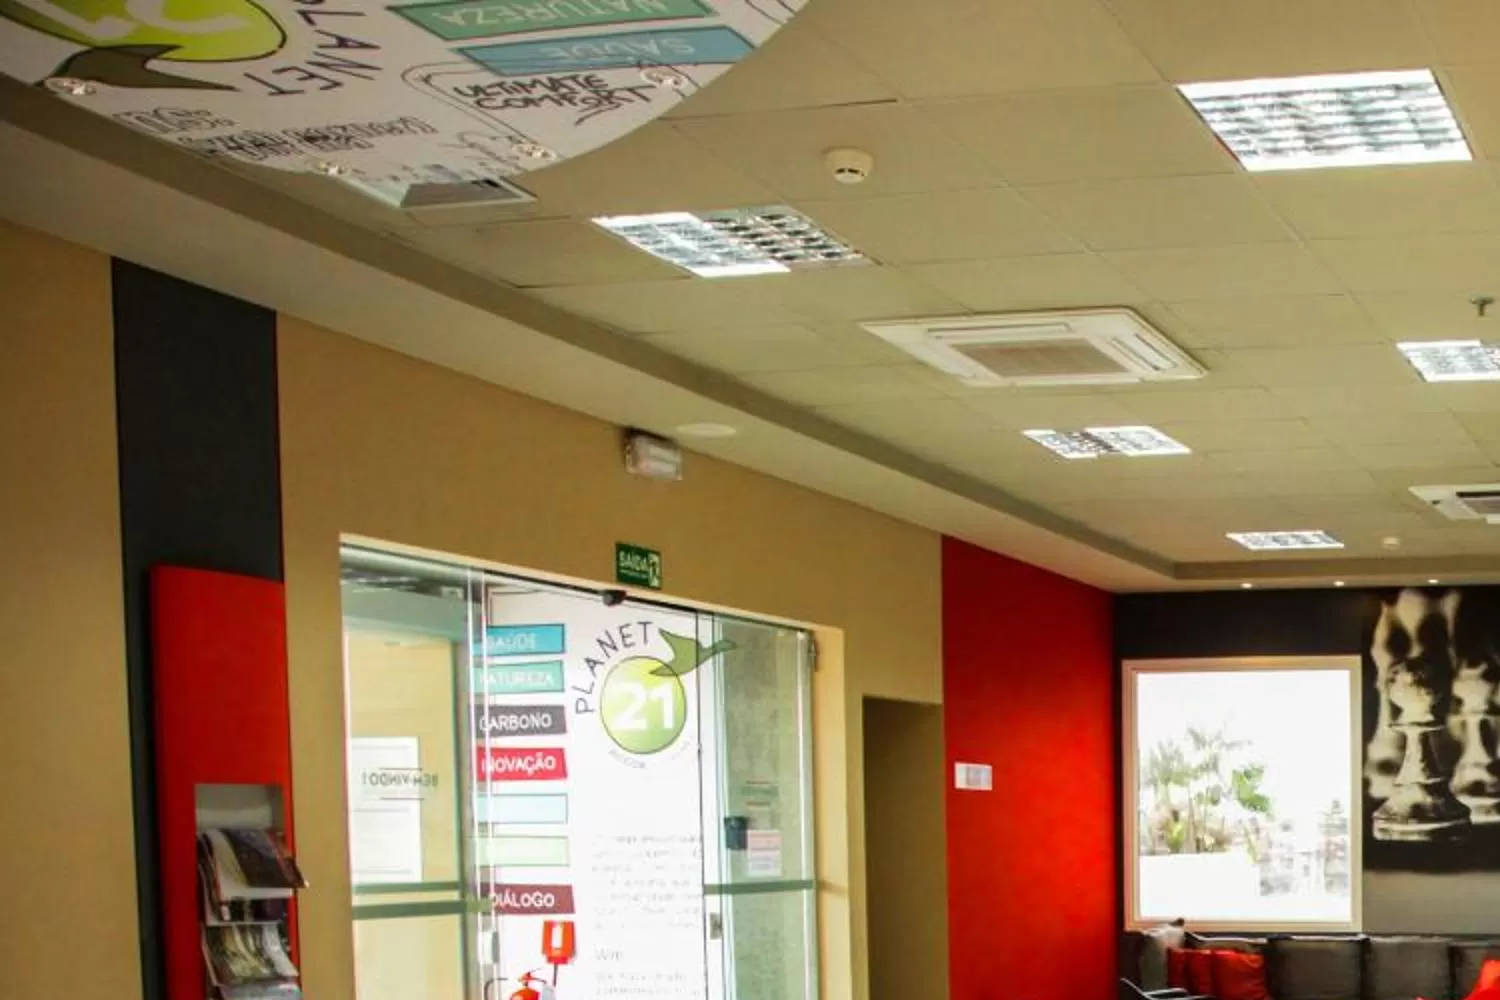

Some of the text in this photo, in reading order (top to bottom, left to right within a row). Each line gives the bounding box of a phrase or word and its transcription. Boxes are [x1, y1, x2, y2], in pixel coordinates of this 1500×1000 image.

[244, 0, 384, 97] LANET
[571, 620, 654, 715] PLANET
[479, 711, 552, 732] CARBONO
[608, 682, 676, 731] 21
